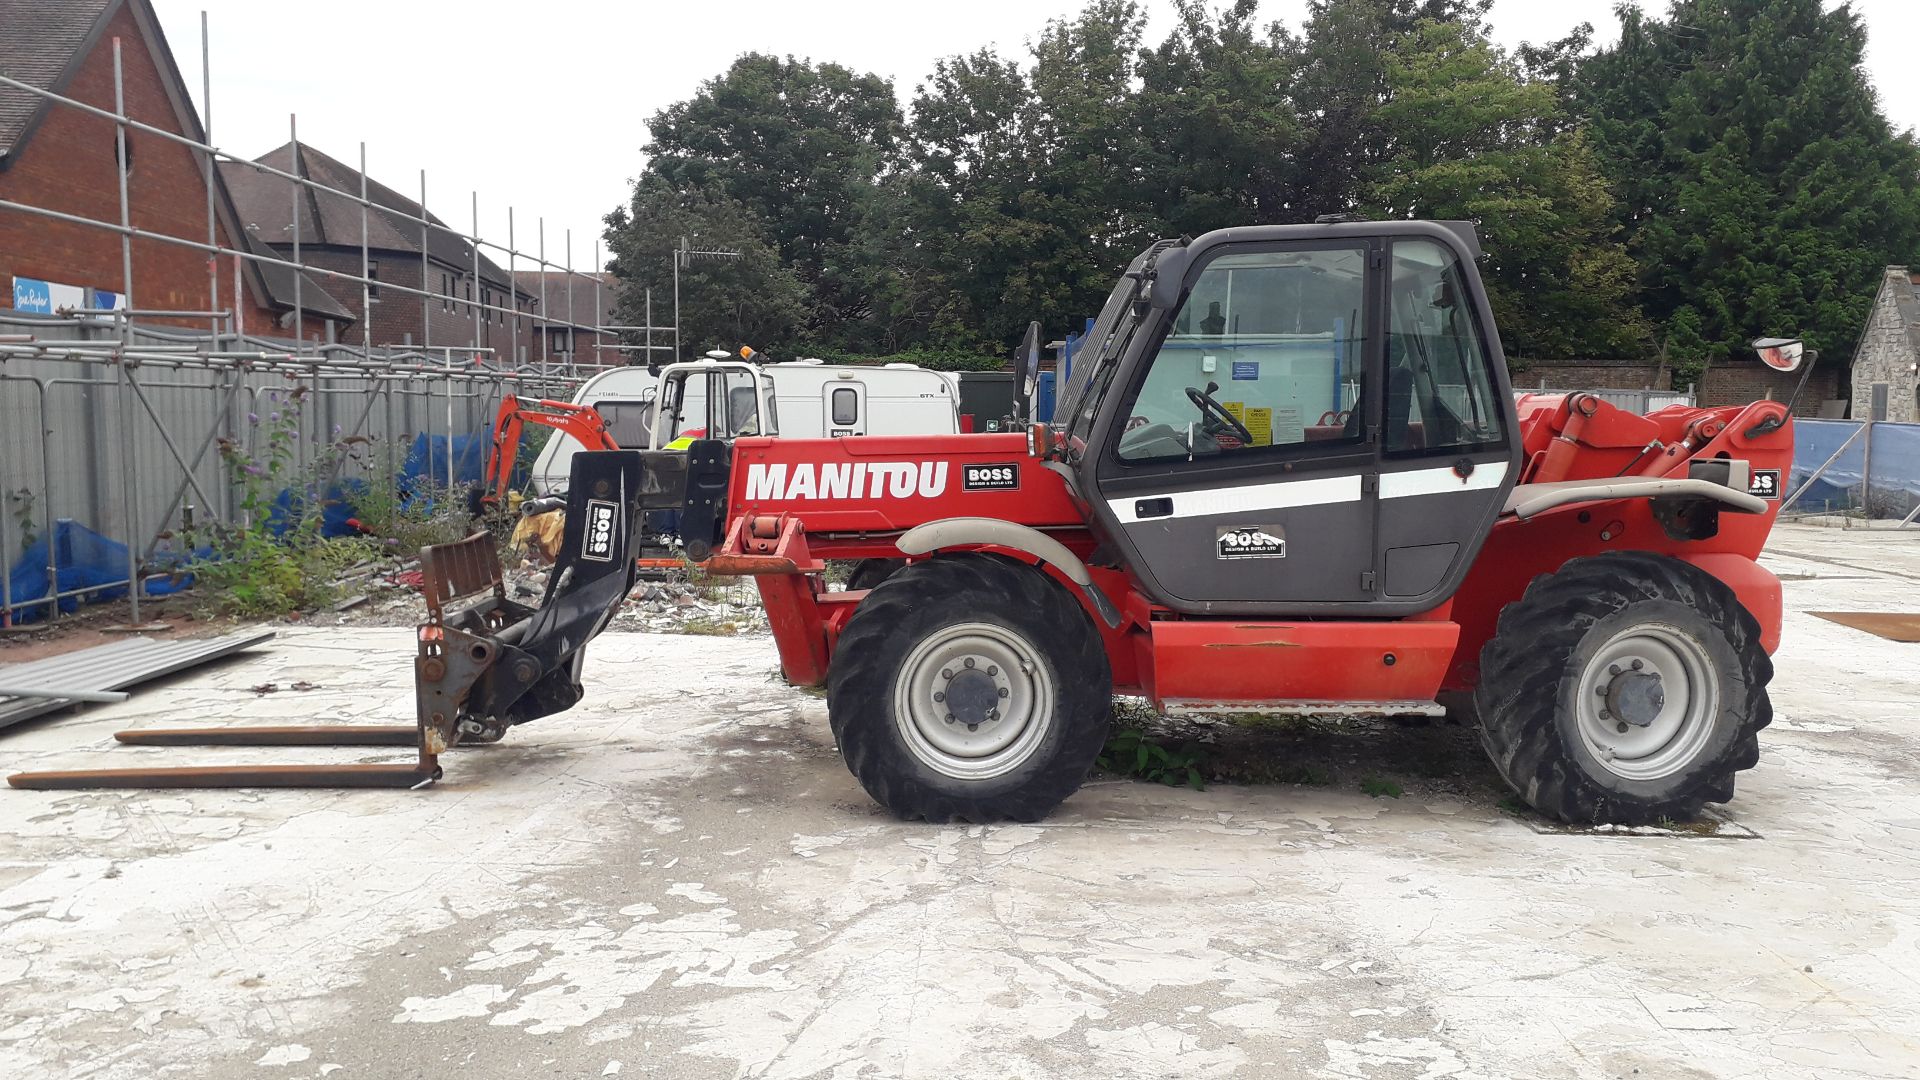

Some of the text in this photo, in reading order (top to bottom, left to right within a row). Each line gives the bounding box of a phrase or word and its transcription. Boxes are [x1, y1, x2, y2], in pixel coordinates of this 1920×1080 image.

[17, 285, 48, 312] Sue Ryder
[745, 461, 949, 500] MANITOU
[968, 468, 1013, 481] BOSS
[594, 508, 612, 553] BOSS
